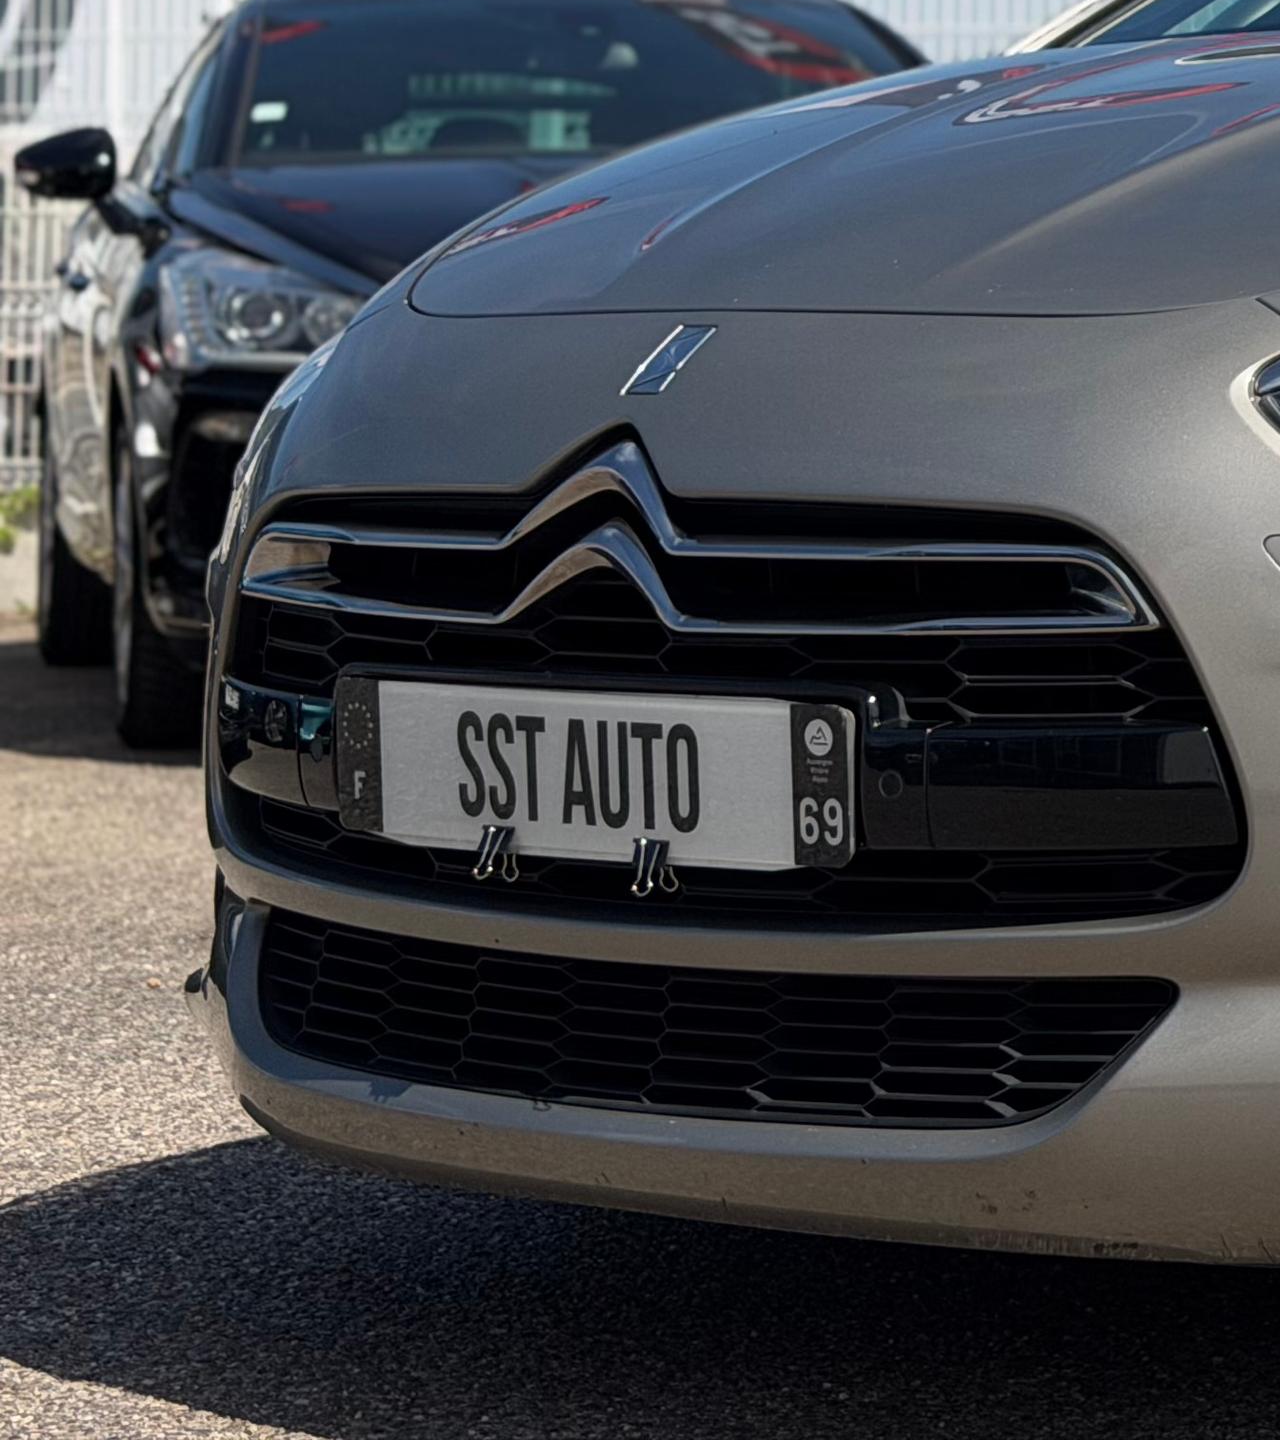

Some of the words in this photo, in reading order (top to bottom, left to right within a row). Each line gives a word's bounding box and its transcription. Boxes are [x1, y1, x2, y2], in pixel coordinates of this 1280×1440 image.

[353, 770, 367, 800] F
[457, 710, 546, 822] SST
[561, 717, 700, 833] AUTO
[800, 796, 843, 846] 69
